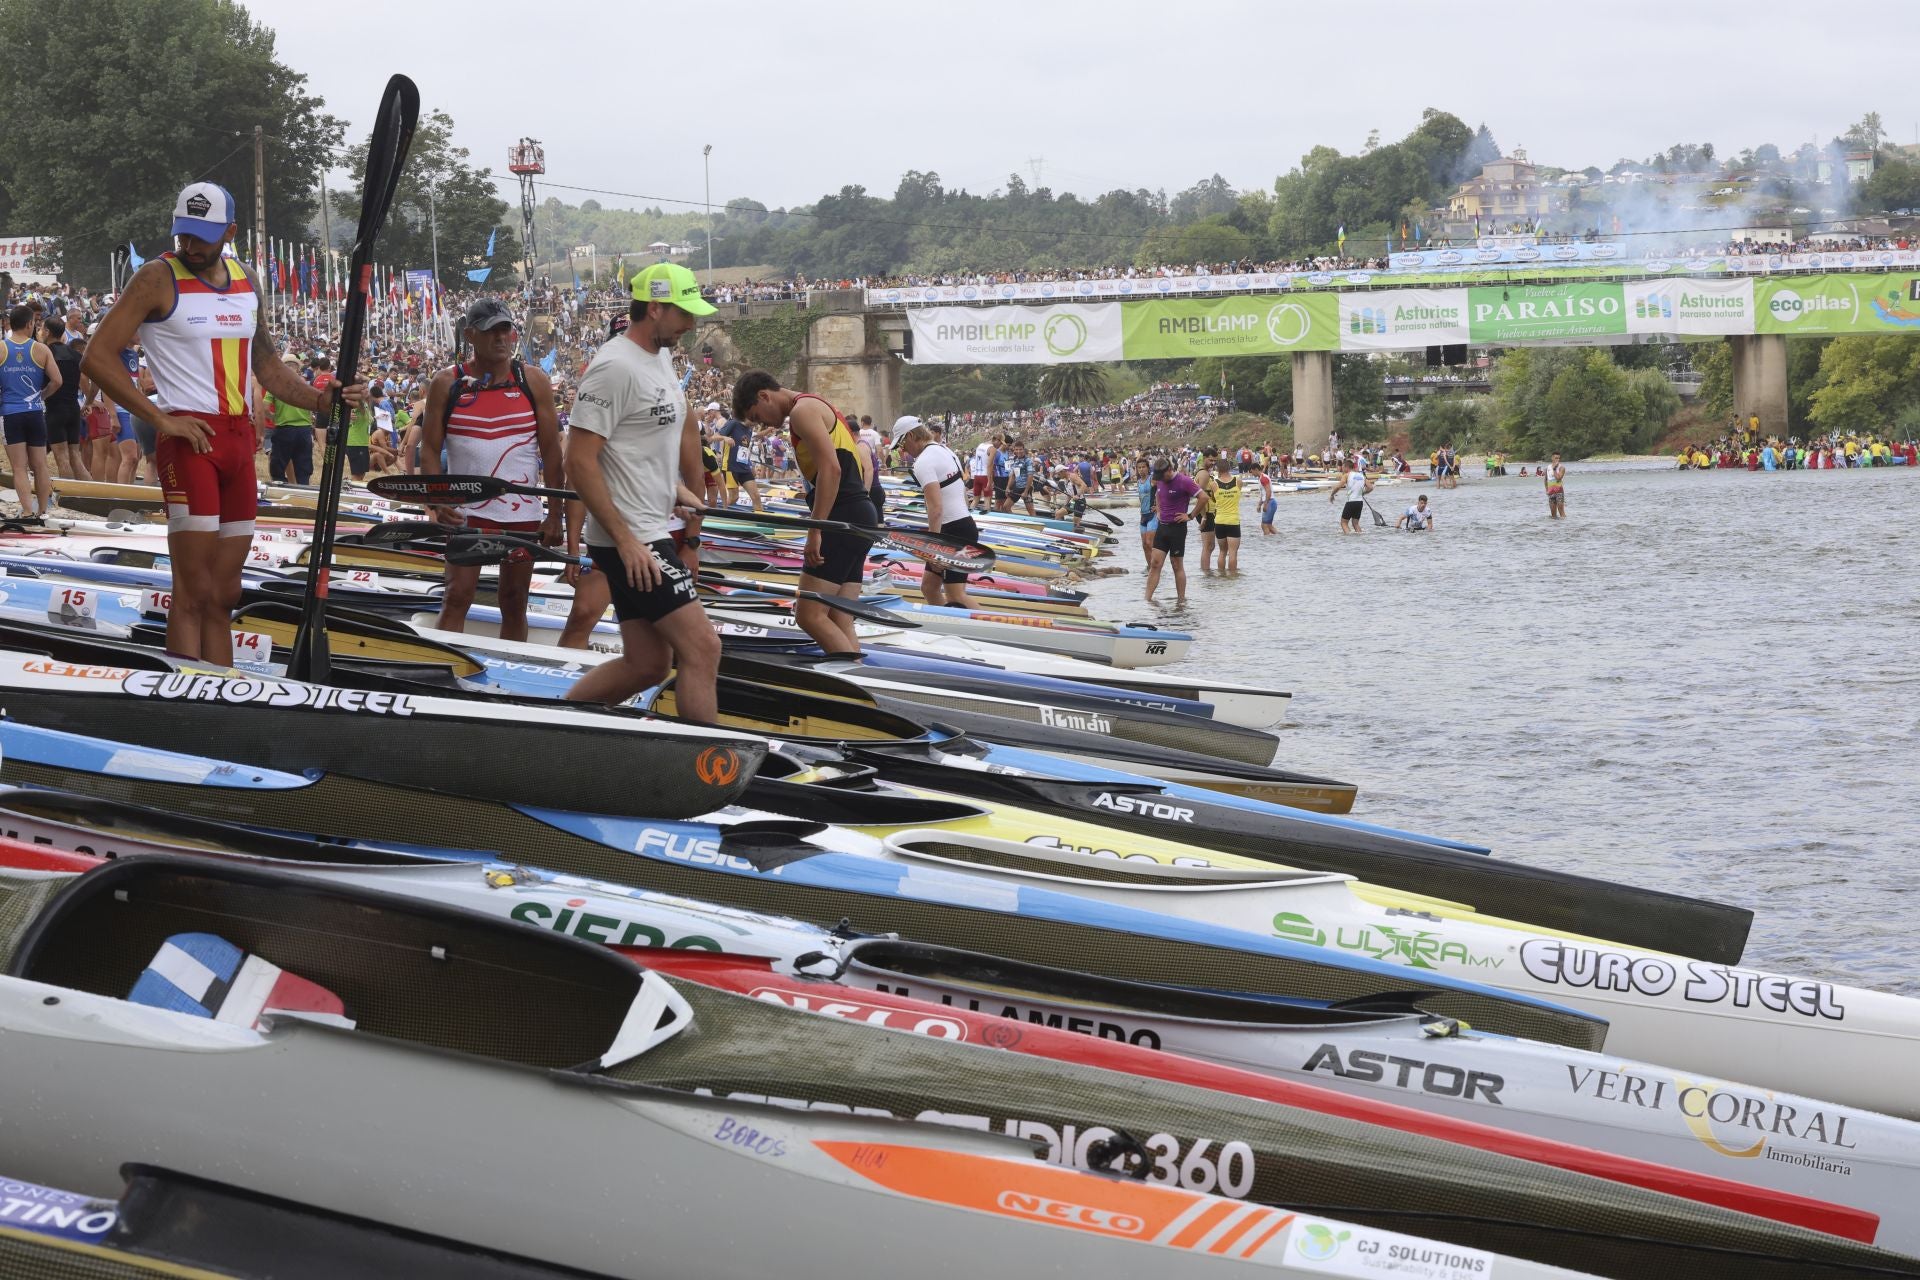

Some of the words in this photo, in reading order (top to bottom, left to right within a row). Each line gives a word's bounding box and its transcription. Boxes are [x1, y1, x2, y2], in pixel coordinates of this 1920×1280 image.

[1525, 286, 1554, 298] Vuelve
[1557, 286, 1568, 296] al
[1680, 292, 1744, 308] Asturias
[1394, 303, 1459, 321] Asturias
[1474, 295, 1619, 323] PARAÍSO
[1770, 294, 1850, 314] ecopilas
[1714, 309, 1744, 318] natural
[937, 323, 1036, 341] AMBILAMP
[1159, 314, 1258, 335] AMBILAMP
[1429, 320, 1459, 329] natural
[1496, 326, 1527, 339] Vuelve
[1537, 326, 1564, 336] sentir
[1567, 324, 1606, 335] Asturias
[967, 344, 1014, 353] Reciclamos
[1189, 336, 1236, 346] Reciclamos
[650, 405, 675, 417] RACE
[658, 415, 676, 425] ONE
[167, 463, 177, 488] ESP
[357, 504, 369, 512] 40
[387, 514, 399, 523] 38
[285, 529, 298, 538] 33
[253, 552, 270, 561] 25
[353, 571, 371, 582] 22
[61, 589, 86, 606] 15
[151, 592, 172, 610] 16
[734, 623, 761, 635] 99
[235, 632, 260, 650] 14
[23, 660, 130, 680] ASTOR
[121, 670, 265, 703] EURO
[268, 682, 416, 717] STEEL
[1040, 704, 1111, 735] Román
[1244, 785, 1310, 796] MACH
[1091, 791, 1196, 824] ASTOR
[1468, 953, 1505, 970] MV
[1519, 938, 1677, 997] EURO
[1684, 960, 1845, 1021] STEEL
[1301, 1043, 1505, 1105] ASTOR
[1565, 1064, 1668, 1110] VERI
[1678, 1087, 1857, 1150] CORRAL
[1765, 1145, 1853, 1177] Inmobiliaria
[1002, 1190, 1143, 1232] NELO
[1357, 1239, 1380, 1255] CJ
[1387, 1244, 1486, 1273] SOLUTIONS
